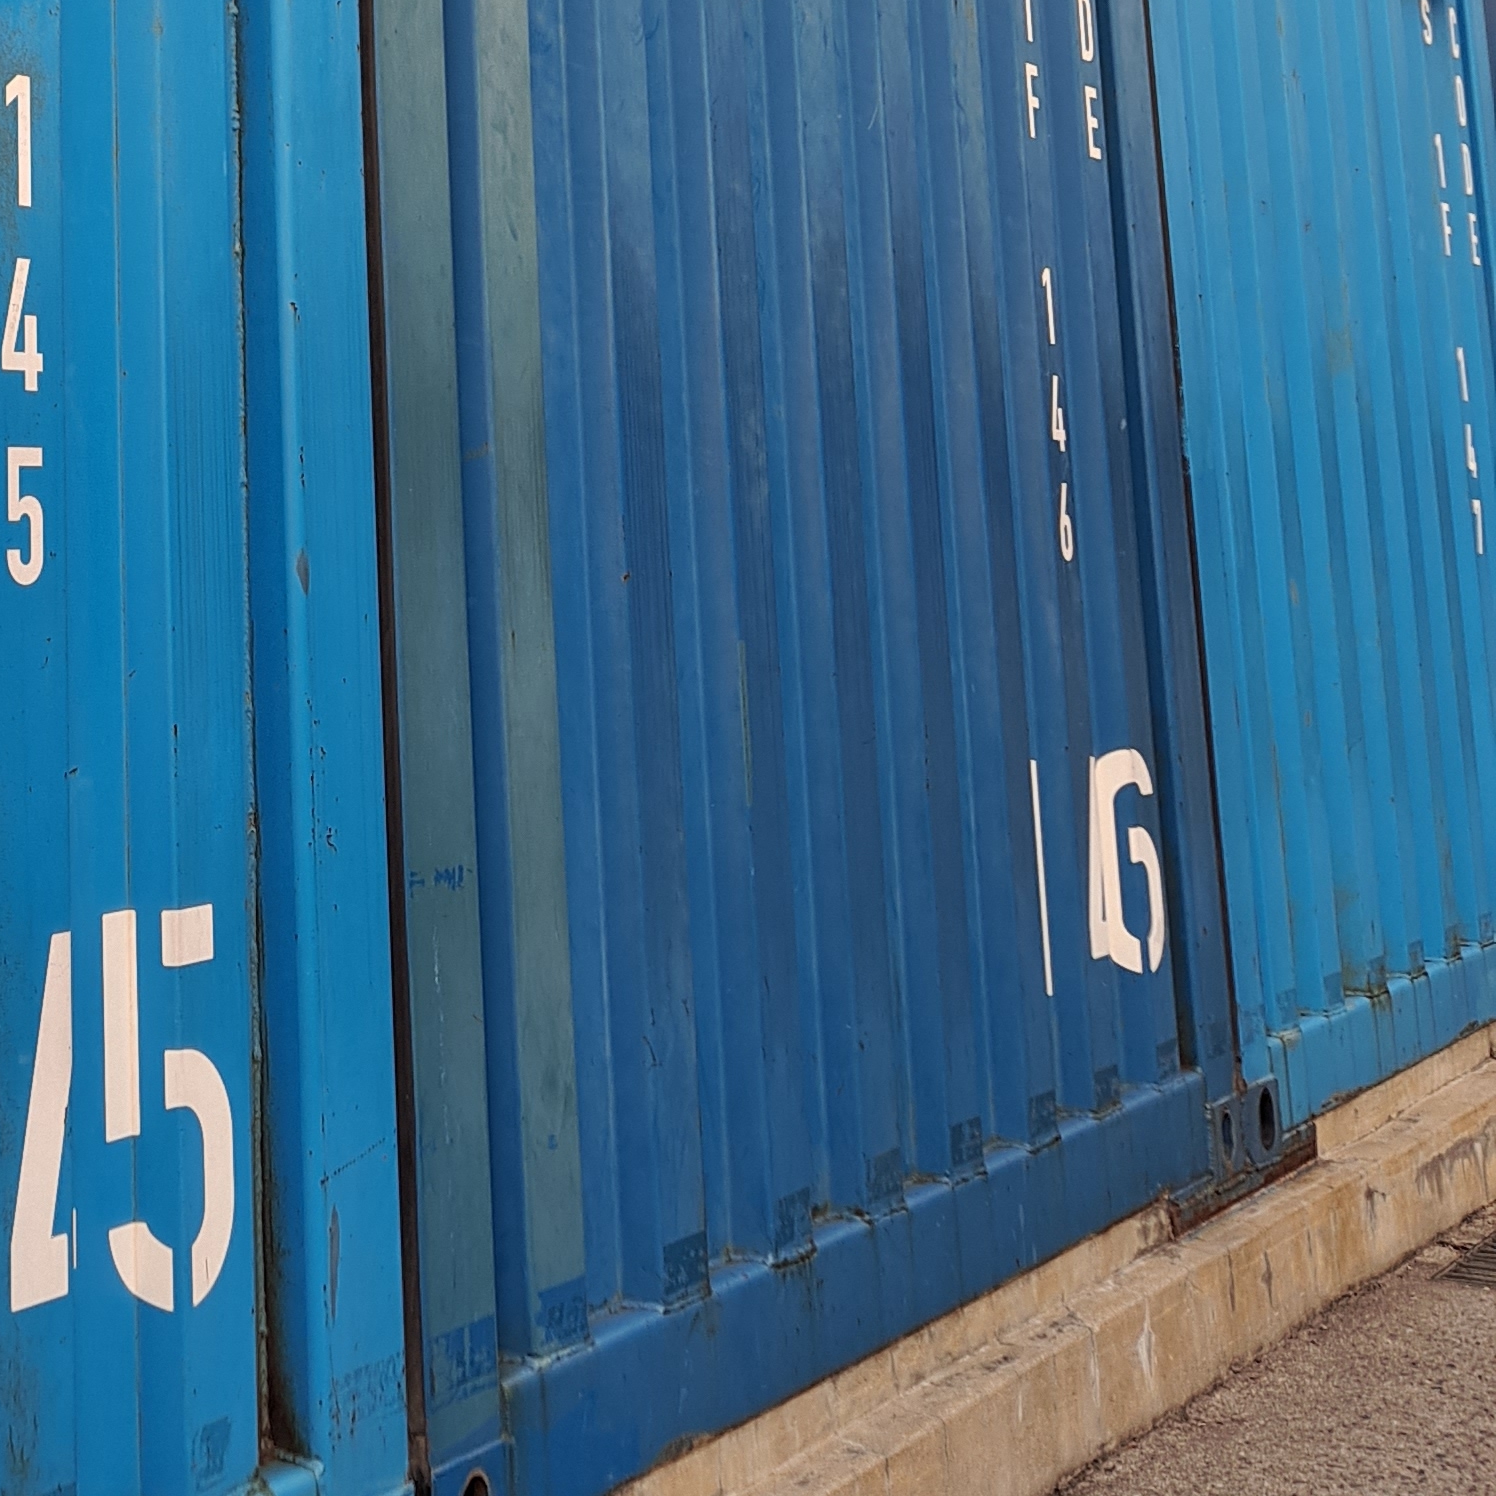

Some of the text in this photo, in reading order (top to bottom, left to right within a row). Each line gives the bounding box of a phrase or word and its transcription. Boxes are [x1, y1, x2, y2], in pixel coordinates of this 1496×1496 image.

[1434, 133, 1452, 256] 1F
[1448, 7, 1481, 266] CODE
[1, 74, 44, 586] 145
[1041, 267, 1074, 562] 146
